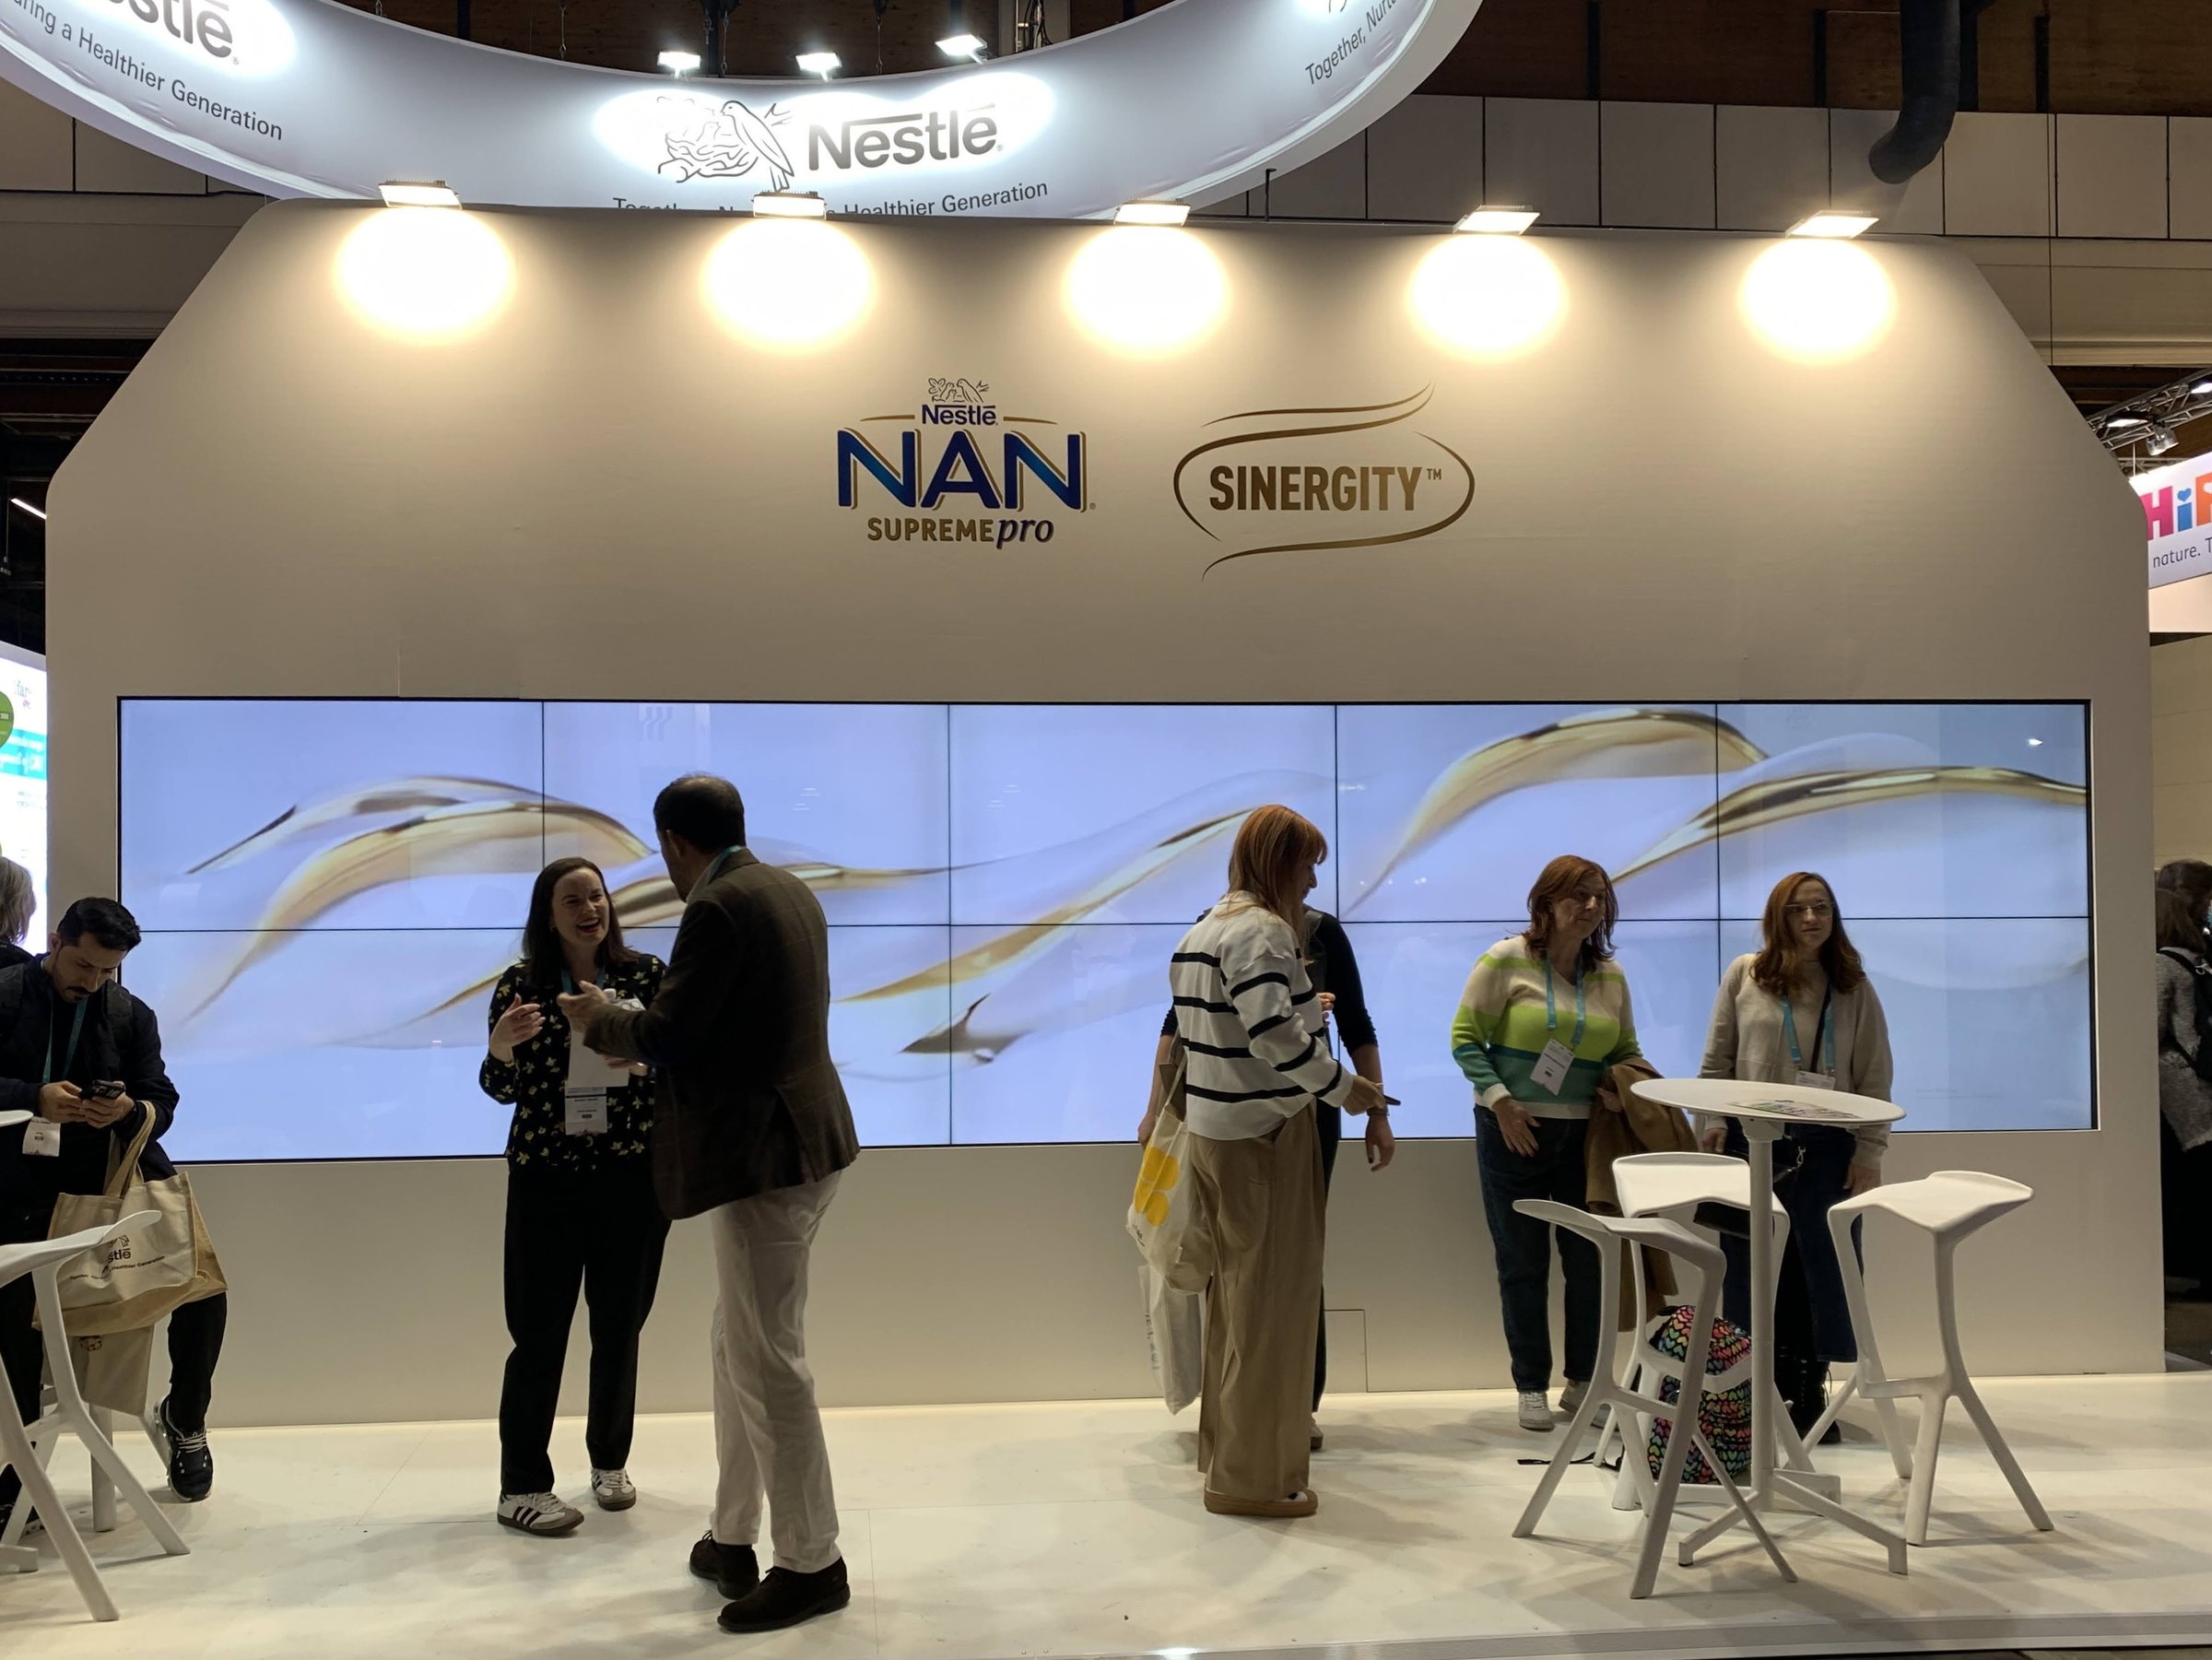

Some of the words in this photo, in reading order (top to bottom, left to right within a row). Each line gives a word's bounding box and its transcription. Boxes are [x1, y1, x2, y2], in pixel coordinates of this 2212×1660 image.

[62, 23, 72, 41] a
[78, 27, 165, 91] Healthier
[171, 79, 282, 140] Generation
[1305, 28, 1366, 85] Together,
[808, 103, 998, 171] Nestlé
[942, 182, 1048, 214] Generation
[922, 404, 997, 425] Nestlé
[837, 428, 1087, 512] NAN
[1209, 465, 1422, 511] SINERGITY
[2153, 546, 2201, 568] nature.
